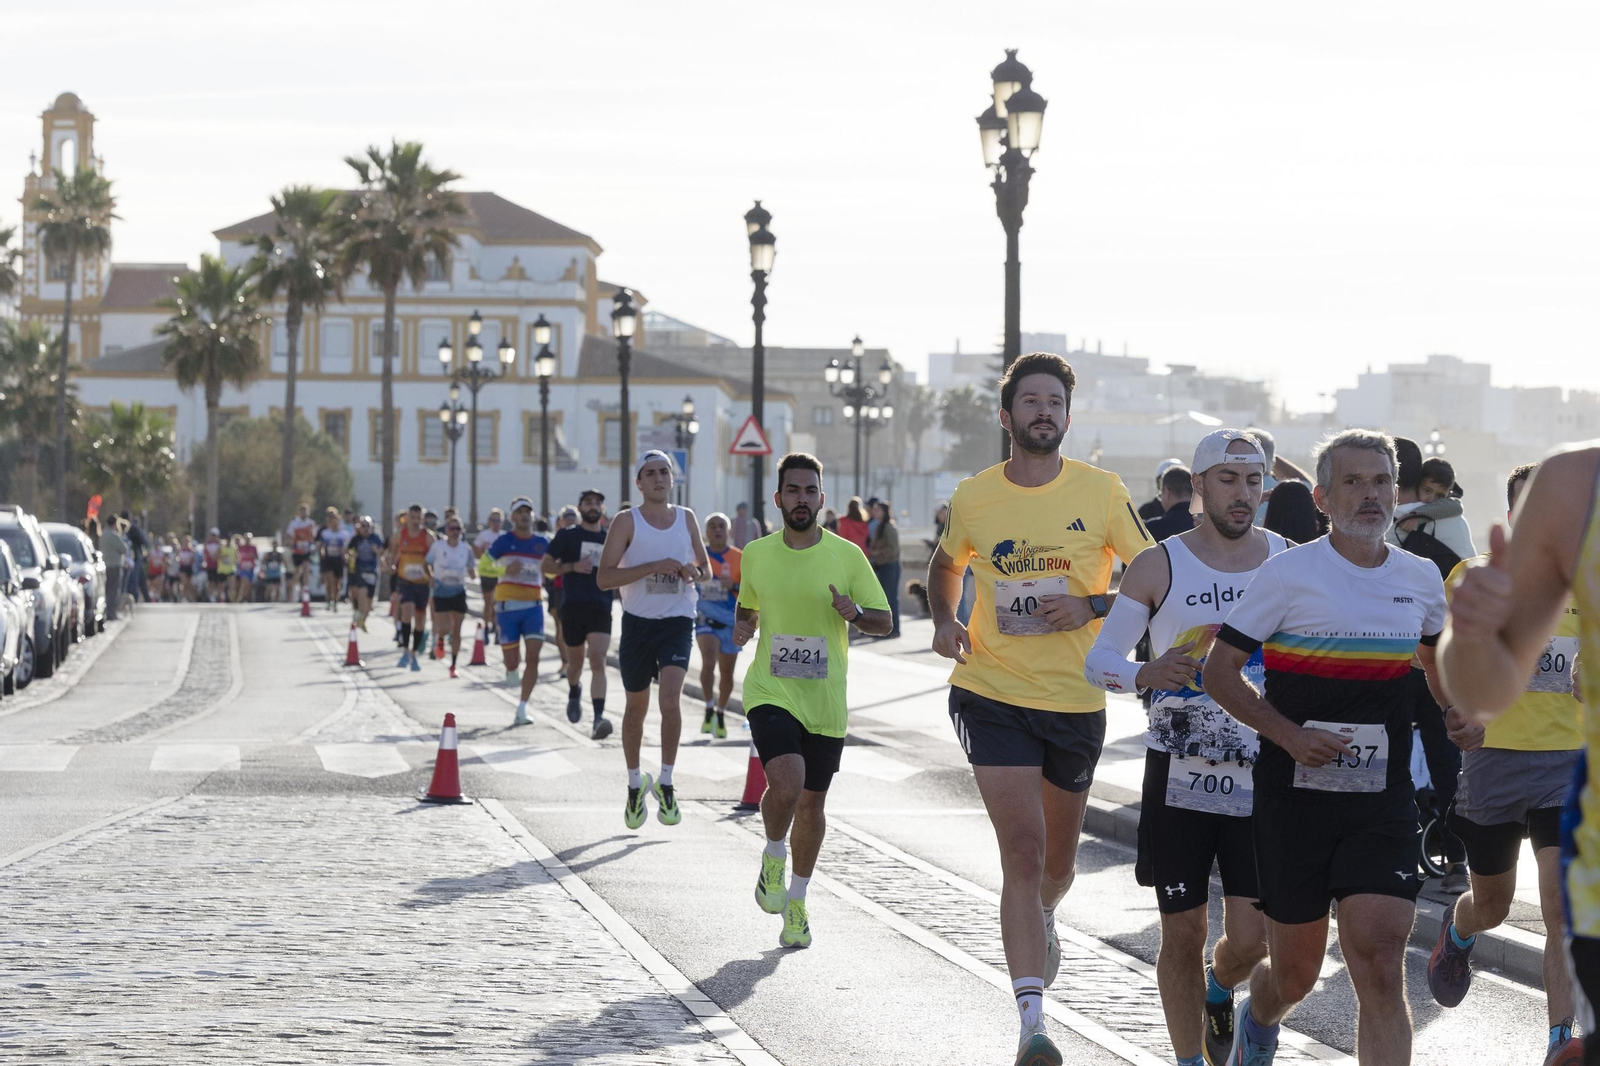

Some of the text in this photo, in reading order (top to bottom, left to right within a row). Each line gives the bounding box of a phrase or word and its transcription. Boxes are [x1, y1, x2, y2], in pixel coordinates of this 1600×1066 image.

[1010, 596, 1038, 616] 40
[778, 647, 821, 664] 2421
[1540, 653, 1566, 673] 30
[1321, 745, 1379, 769] 437
[1188, 771, 1235, 796] 700
